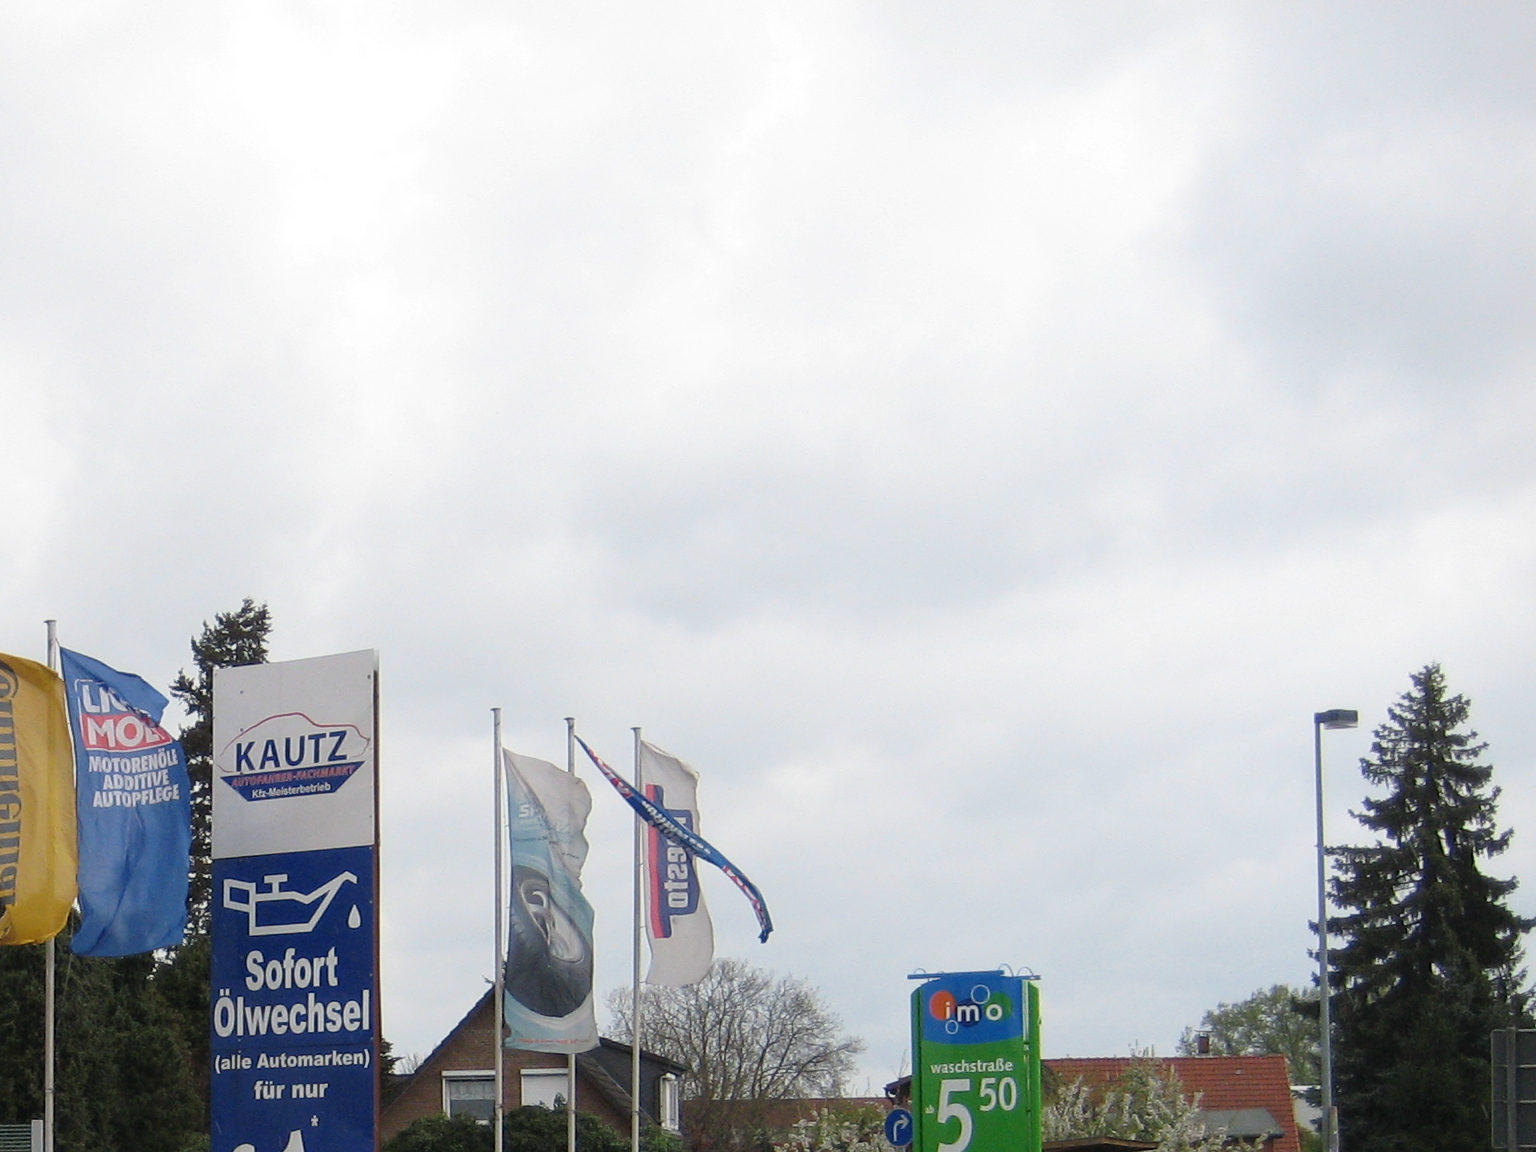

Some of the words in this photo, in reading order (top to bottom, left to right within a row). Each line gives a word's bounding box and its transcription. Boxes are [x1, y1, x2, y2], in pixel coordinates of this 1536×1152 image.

[87, 716, 165, 747] MOL
[88, 748, 179, 774] MOTORENÖLE
[235, 730, 348, 772] KAUTZ
[102, 769, 170, 791] ADDITIVE
[251, 782, 331, 799] Kfz-Meisterbetrieb
[93, 784, 180, 808] AUTOPFLEGE
[245, 946, 339, 991] Sofort
[214, 988, 370, 1038] Ölwechsel
[945, 1001, 1003, 1022] imo
[256, 1048, 370, 1069] Automarken)
[930, 1058, 1014, 1074] waschstraße
[254, 1080, 285, 1100] für
[291, 1083, 329, 1099] nur
[979, 1077, 1017, 1112] 50
